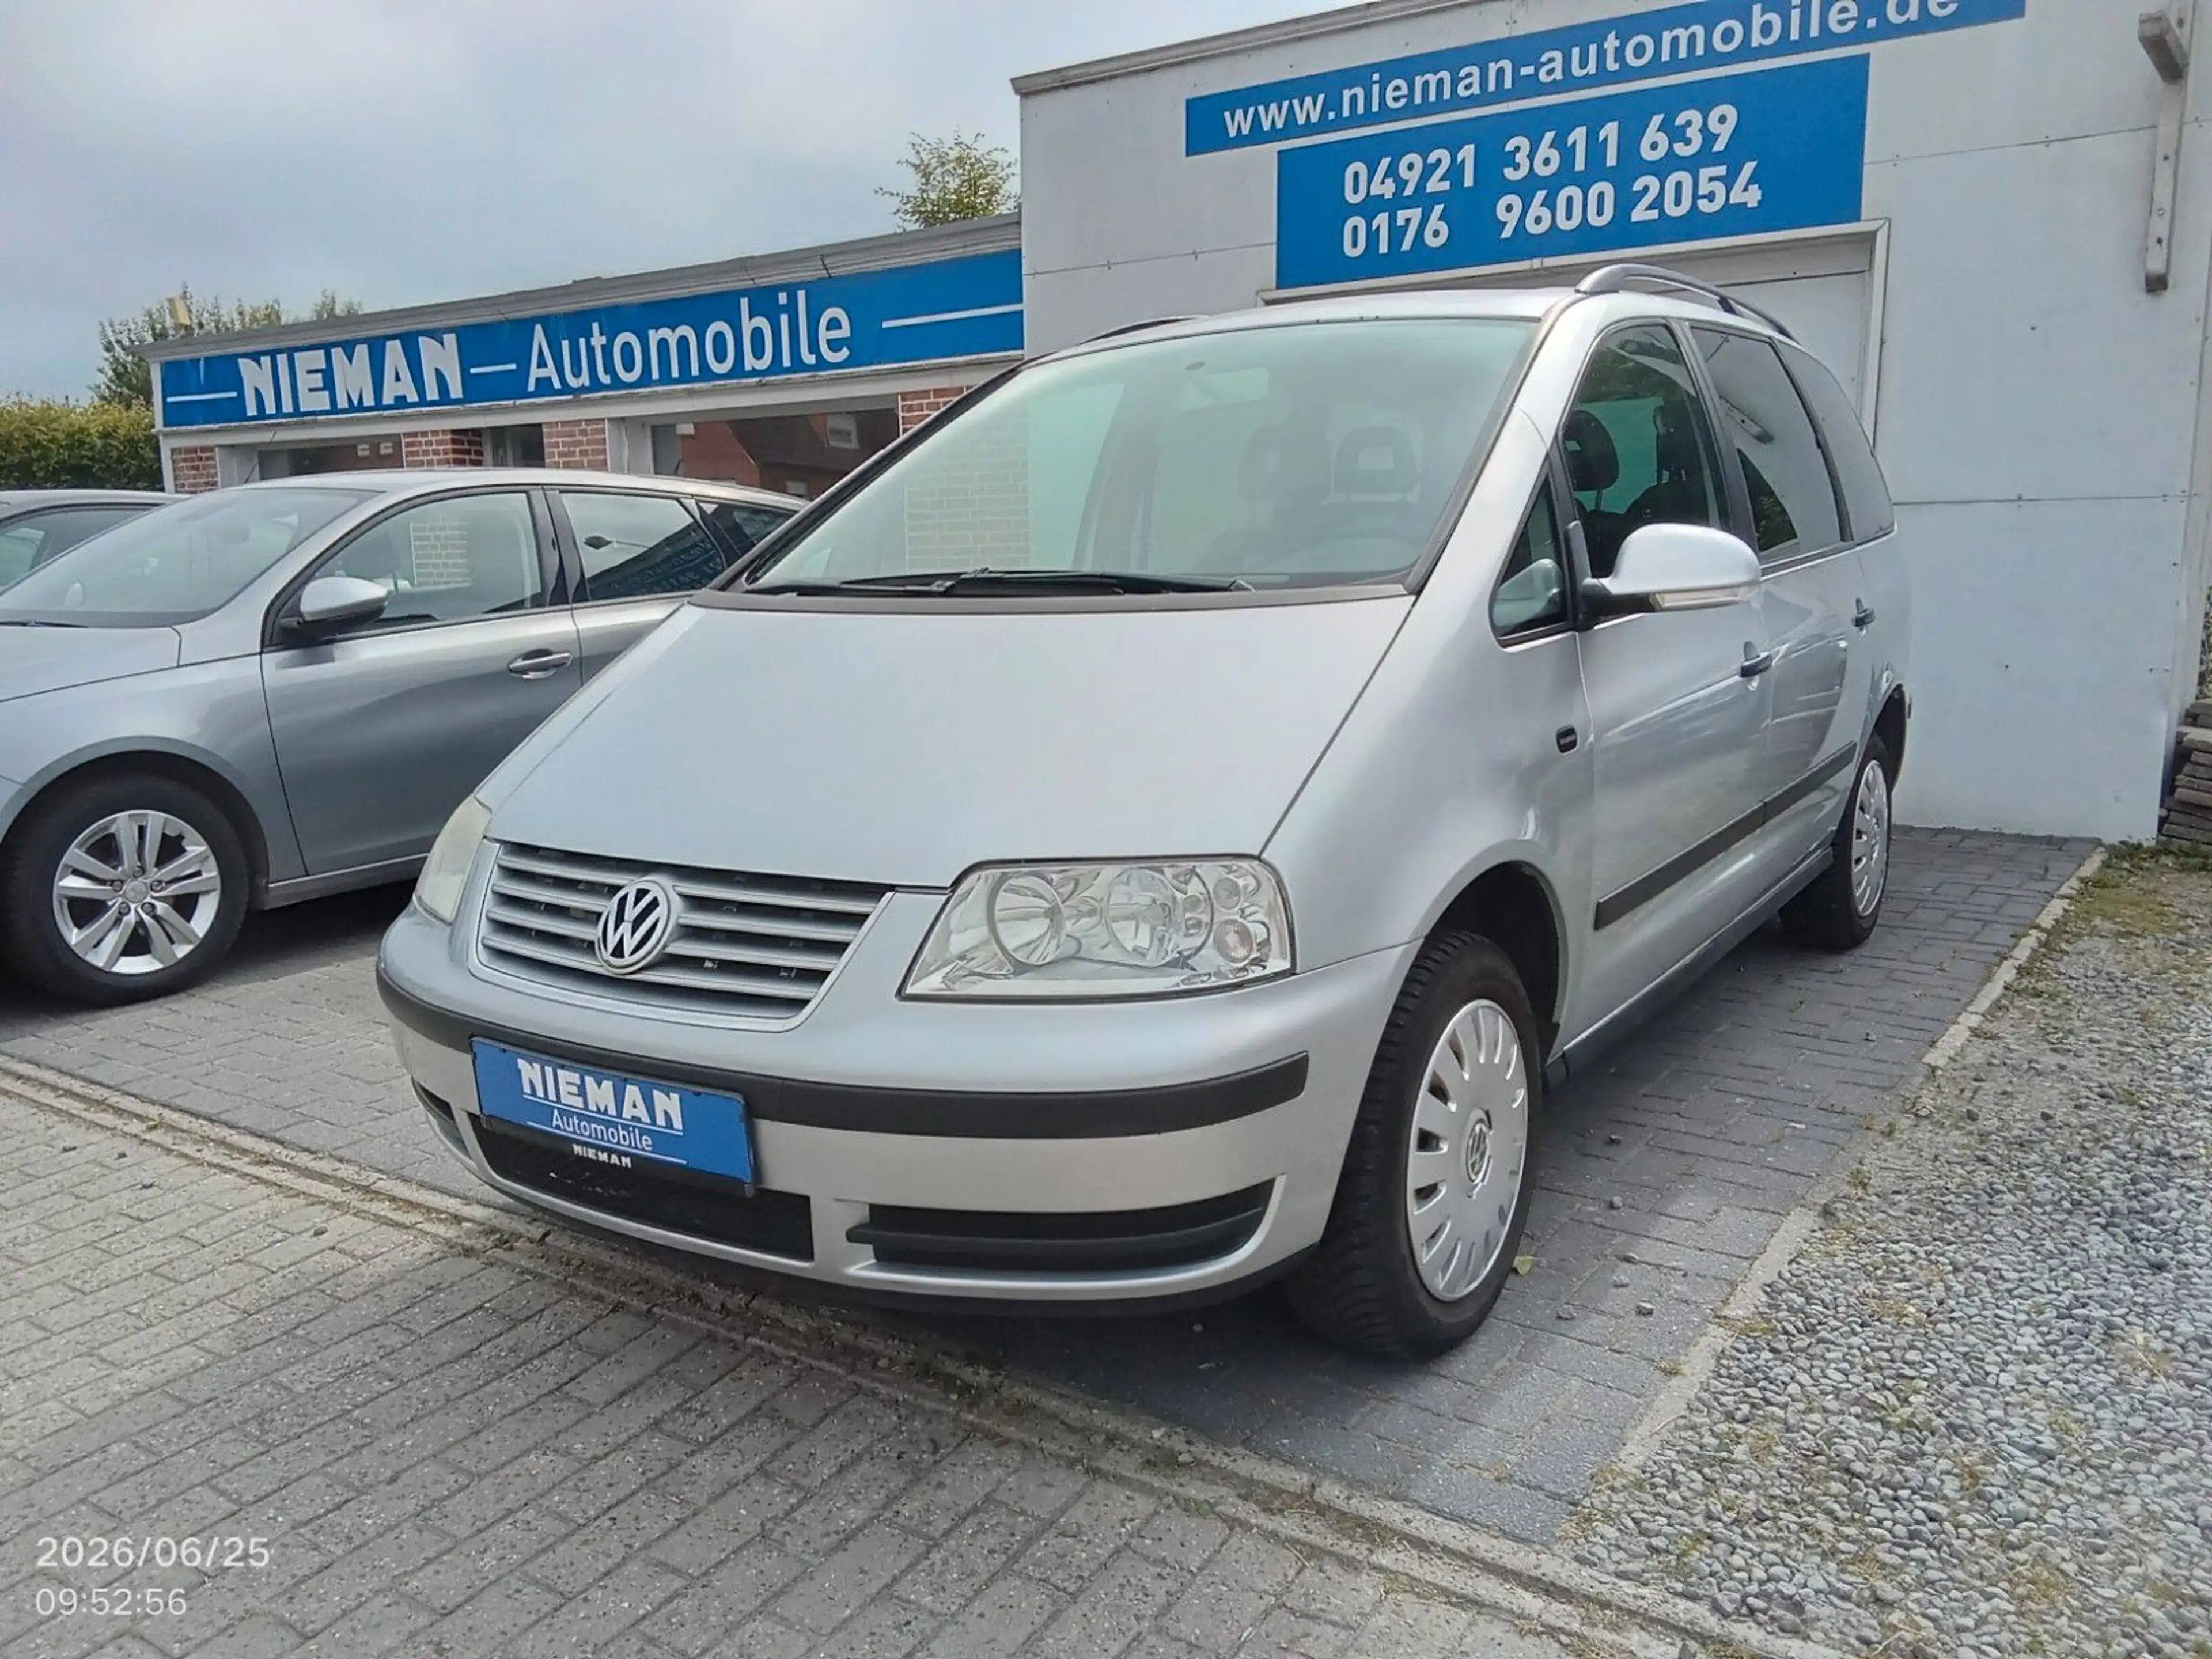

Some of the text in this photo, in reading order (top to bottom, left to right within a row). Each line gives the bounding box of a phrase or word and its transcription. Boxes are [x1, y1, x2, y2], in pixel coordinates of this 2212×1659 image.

[1223, 0, 1959, 138] www.nieman-automobile.de
[1344, 103, 1738, 204] 04921 3611 639
[1343, 160, 1762, 258] 0176 9600 2054
[237, 290, 851, 416] NIEMAN Automobile
[516, 1058, 684, 1130] NIEMAN
[551, 1108, 653, 1152] Automobile
[571, 1143, 632, 1169] NIEMAN
